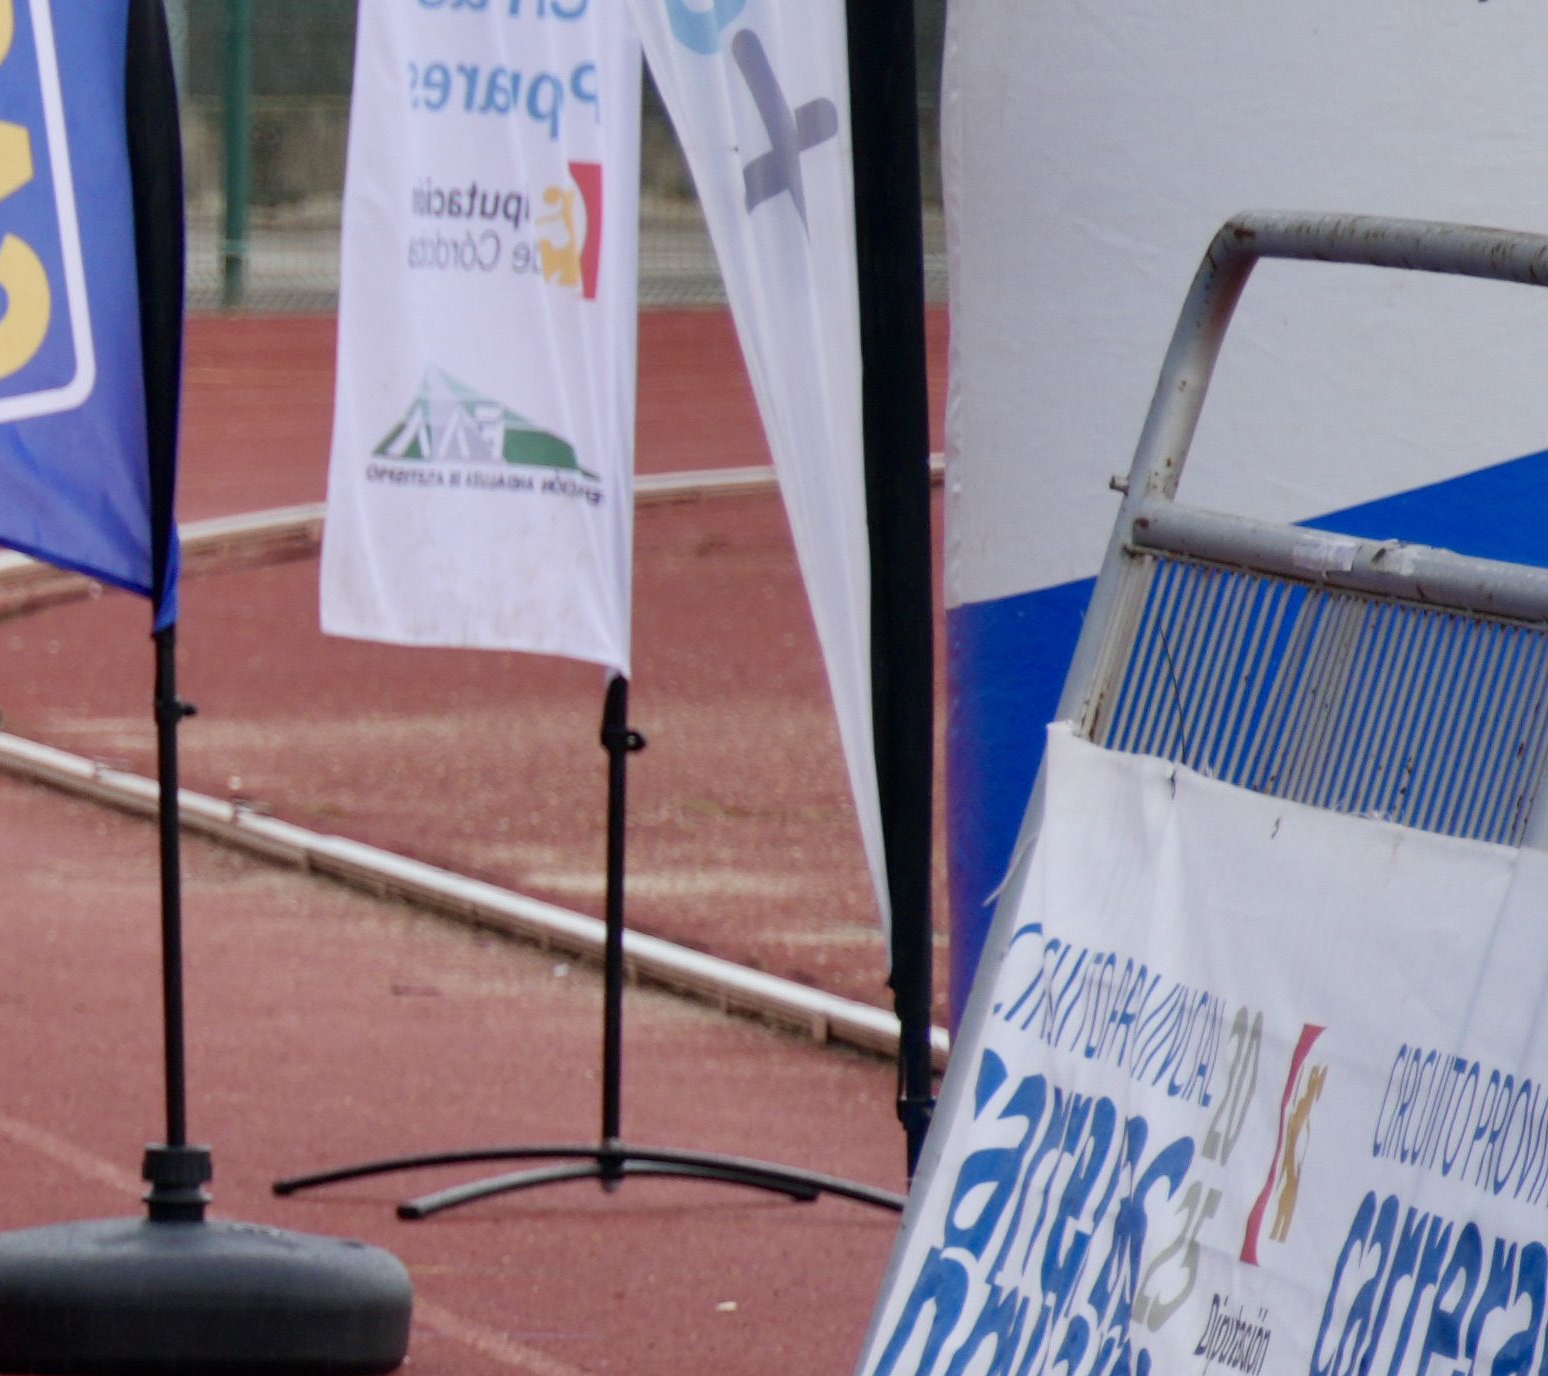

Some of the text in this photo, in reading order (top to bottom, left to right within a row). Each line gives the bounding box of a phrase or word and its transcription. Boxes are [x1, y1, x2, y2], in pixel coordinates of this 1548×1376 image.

[1373, 1042, 1548, 1216] CIRCUITO PROVI
[1194, 1293, 1272, 1376] Diputación
